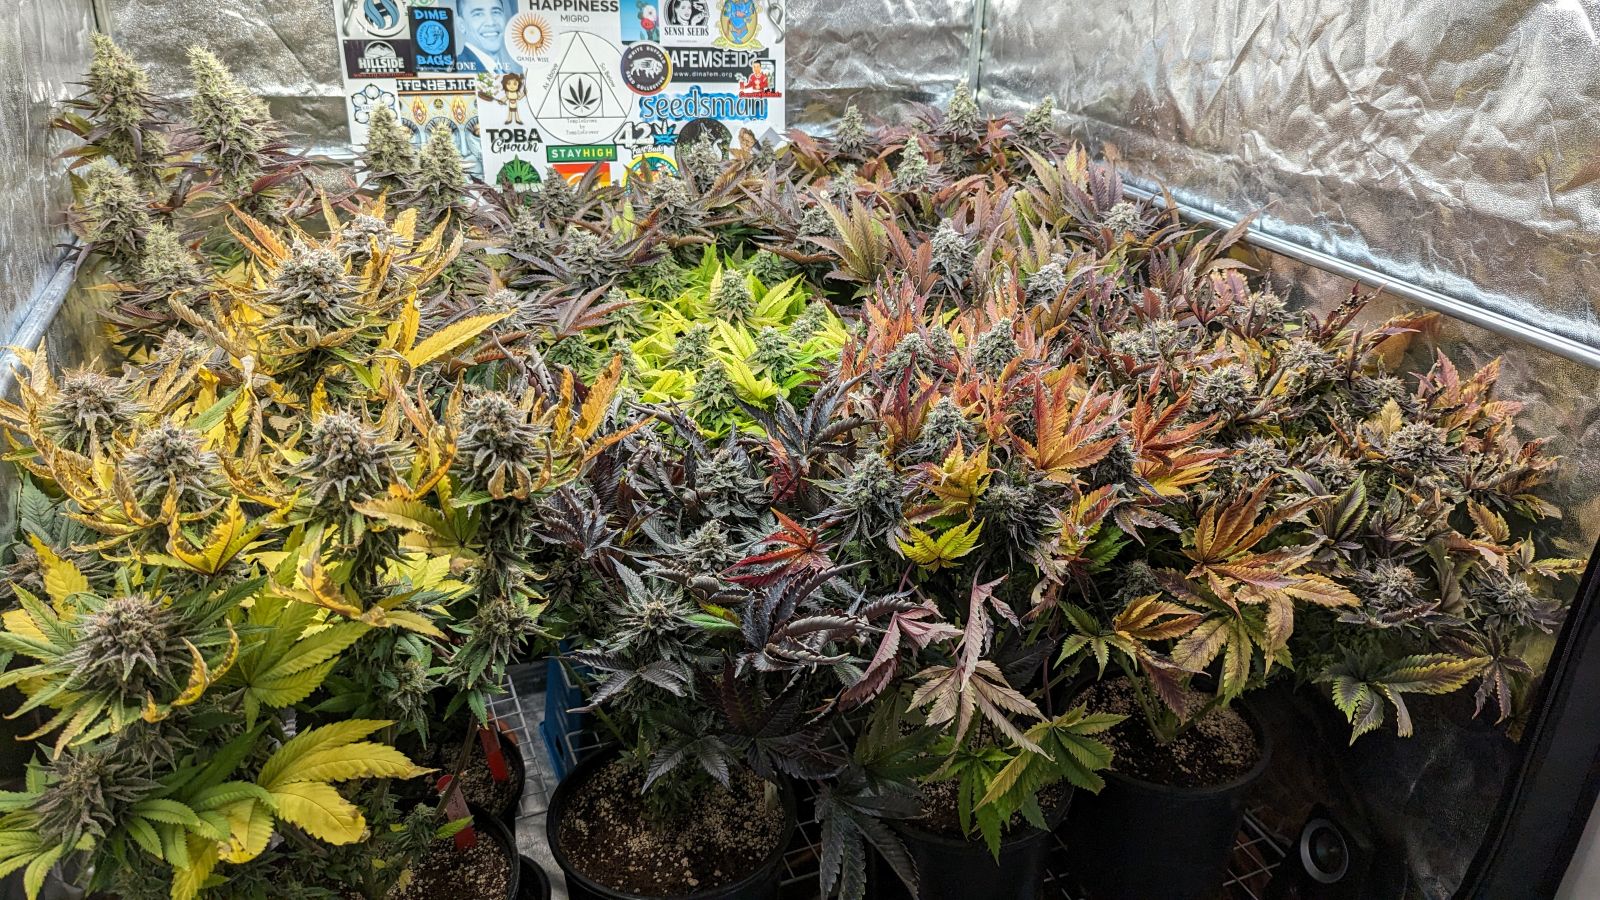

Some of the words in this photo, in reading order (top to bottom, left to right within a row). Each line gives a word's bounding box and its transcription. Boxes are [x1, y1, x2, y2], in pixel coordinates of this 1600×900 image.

[529, 0, 619, 12] HAPPINESS
[414, 9, 448, 20] DIME
[560, 14, 590, 23] MIGRO
[664, 27, 684, 36] SENSI
[687, 27, 709, 37] SEEDS
[416, 54, 454, 66] BAGS
[628, 46, 643, 59] WHITE
[646, 46, 666, 64] BUFFALO
[358, 57, 405, 69] HILLSIDE
[457, 62, 477, 71] ONE
[626, 71, 636, 85] SEED
[636, 76, 666, 91] COLLECTIVE
[643, 88, 765, 119] seedsman
[486, 128, 543, 143] TOBA
[491, 140, 540, 153] Grown
